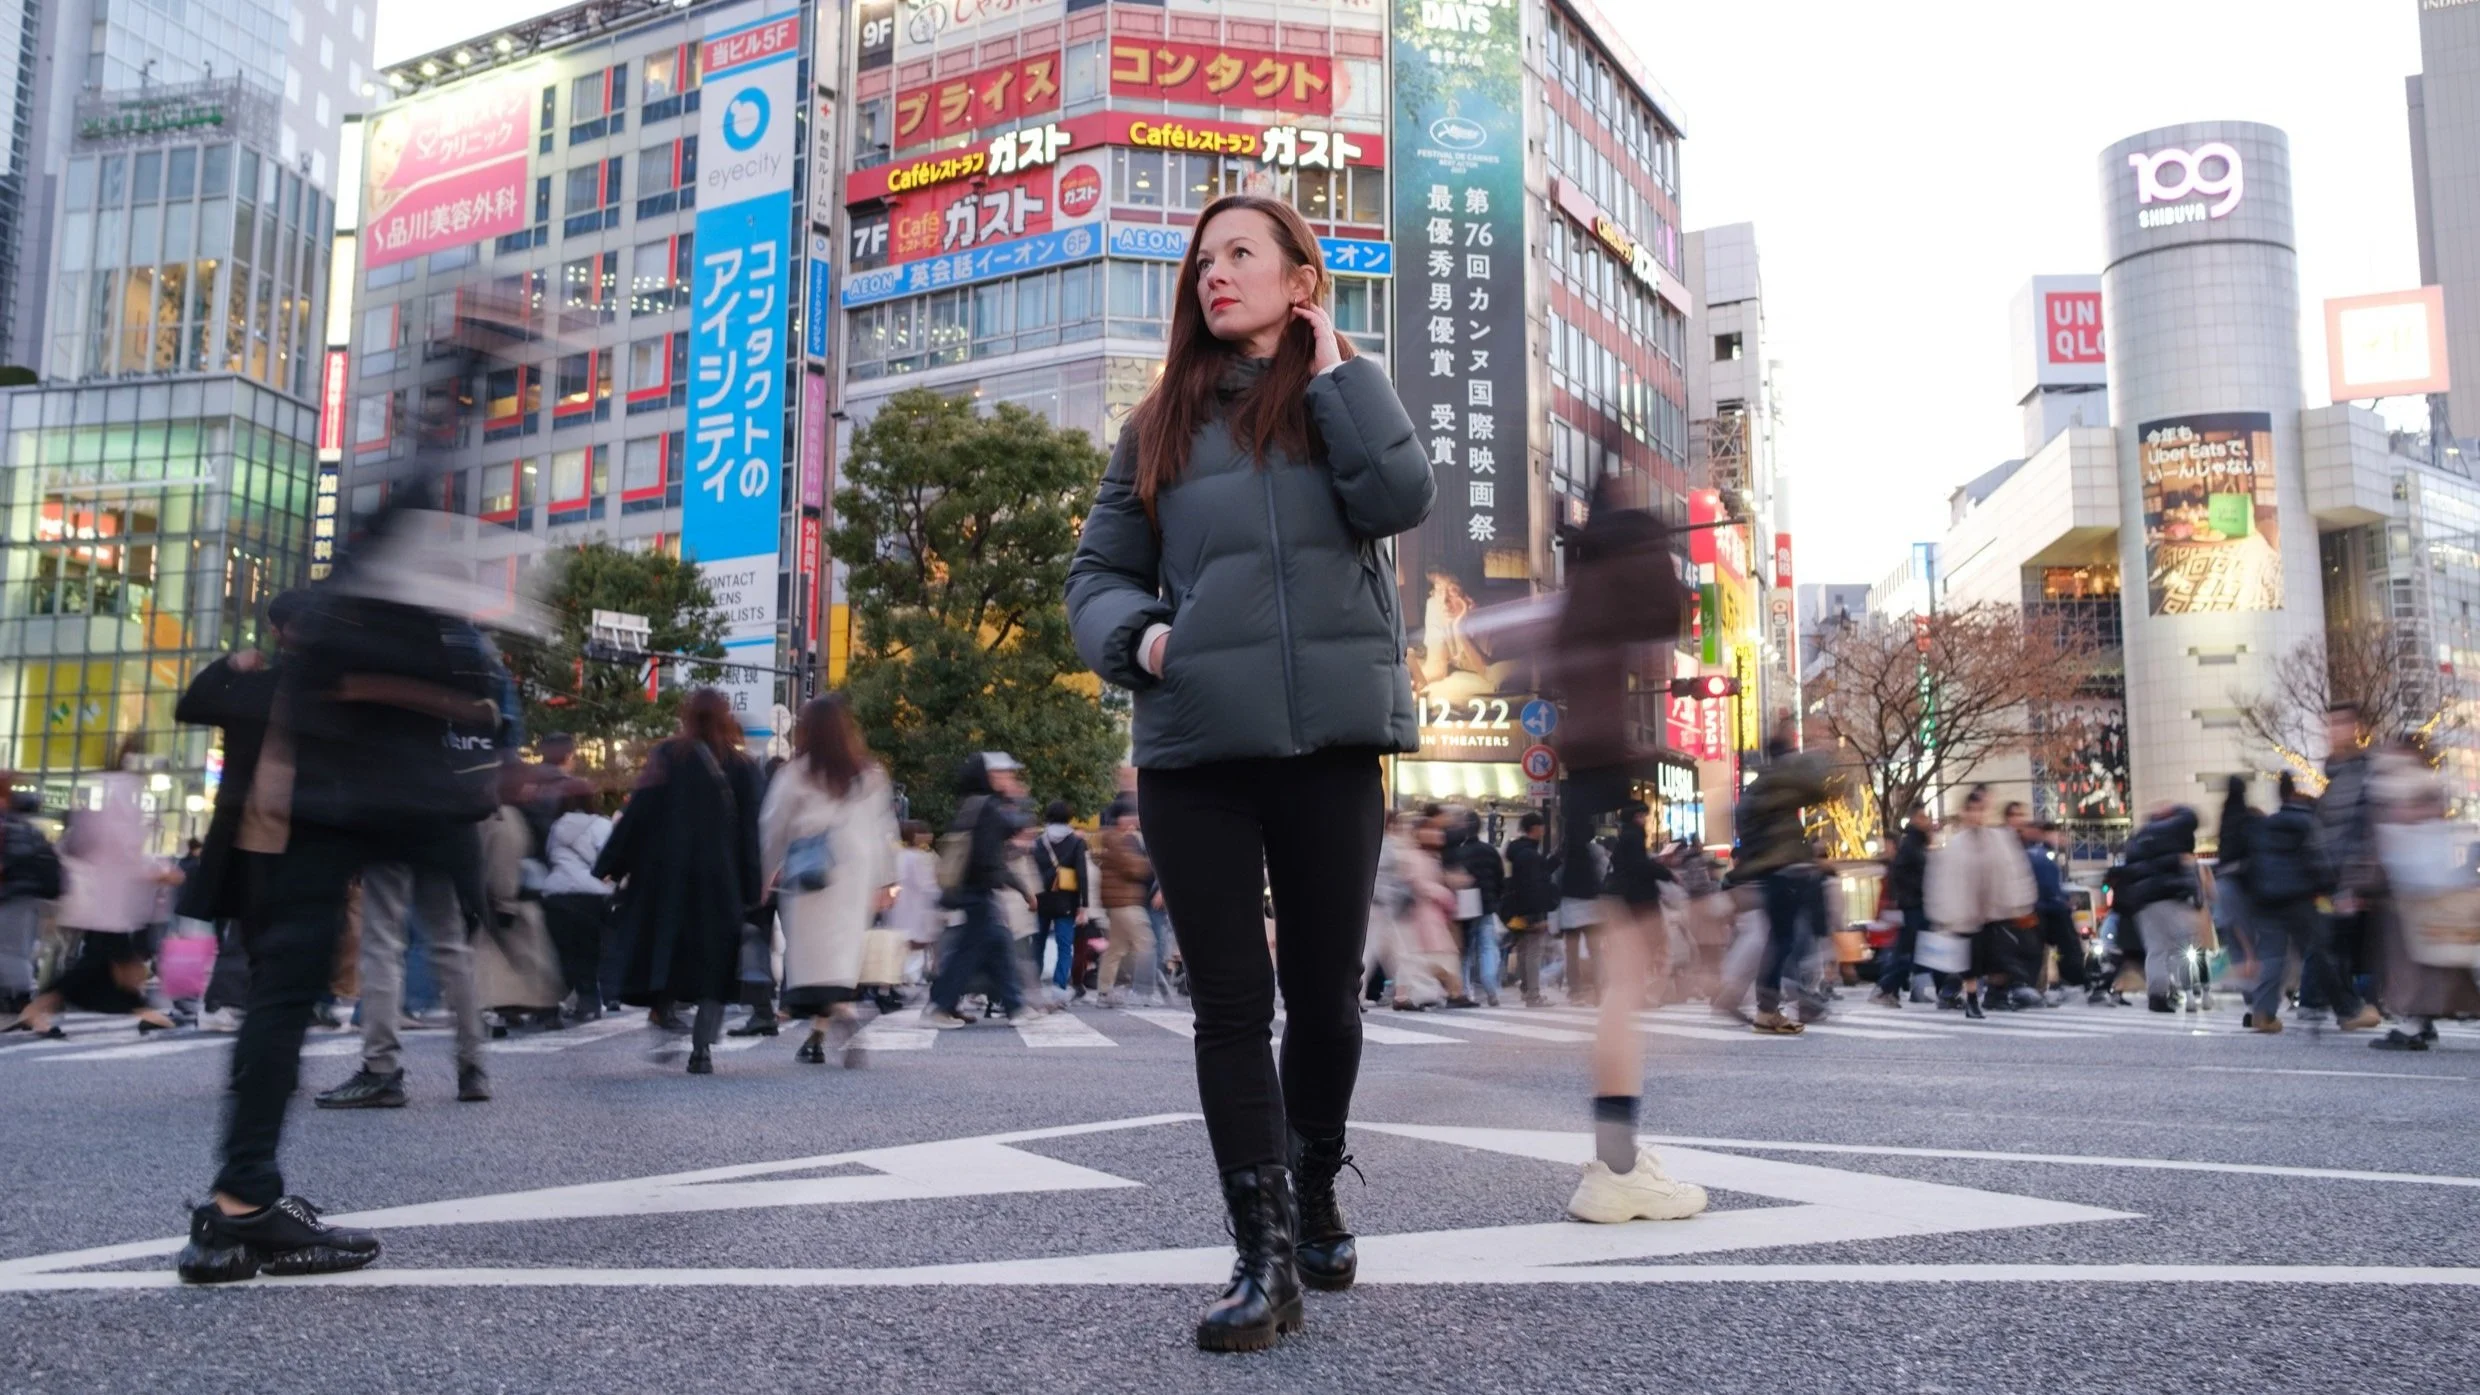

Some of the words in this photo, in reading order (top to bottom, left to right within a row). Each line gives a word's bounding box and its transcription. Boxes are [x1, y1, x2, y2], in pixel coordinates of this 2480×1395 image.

[862, 18, 893, 48] 9F
[1422, 1, 1492, 34] DAYS
[711, 22, 790, 68] 当ビル5F
[1112, 46, 1328, 102] コンタクト
[897, 58, 1059, 137] プライス
[438, 121, 513, 164] クリニック
[988, 123, 1072, 177] ガスト
[1261, 125, 1362, 171] ガスト
[708, 150, 782, 191] eyecity
[2127, 141, 2244, 219] 109
[1063, 185, 1098, 206] ガスト
[2138, 202, 2206, 229] SHIBUYA
[386, 184, 518, 250] 品川美容外科
[898, 210, 940, 239] Café
[942, 186, 1045, 251] ガスト
[853, 222, 889, 258] 7F
[1066, 232, 1089, 254] 6F
[1119, 229, 1184, 251] AEON
[850, 271, 895, 297] AEON
[1426, 184, 1456, 378] 最優秀男優賞
[2053, 299, 2096, 326] UN
[696, 247, 743, 503] アイシティ
[739, 240, 777, 498] コンタクトの
[1464, 186, 1497, 542] 第76回カンヌ国際映画祭
[1429, 403, 1457, 466] 受賞
[2147, 446, 2188, 466] Uber
[1418, 697, 1511, 730] 12.22
[1420, 734, 1436, 745] IN
[1441, 735, 1510, 747] THEATERS
[1657, 761, 1695, 803] LUSH
